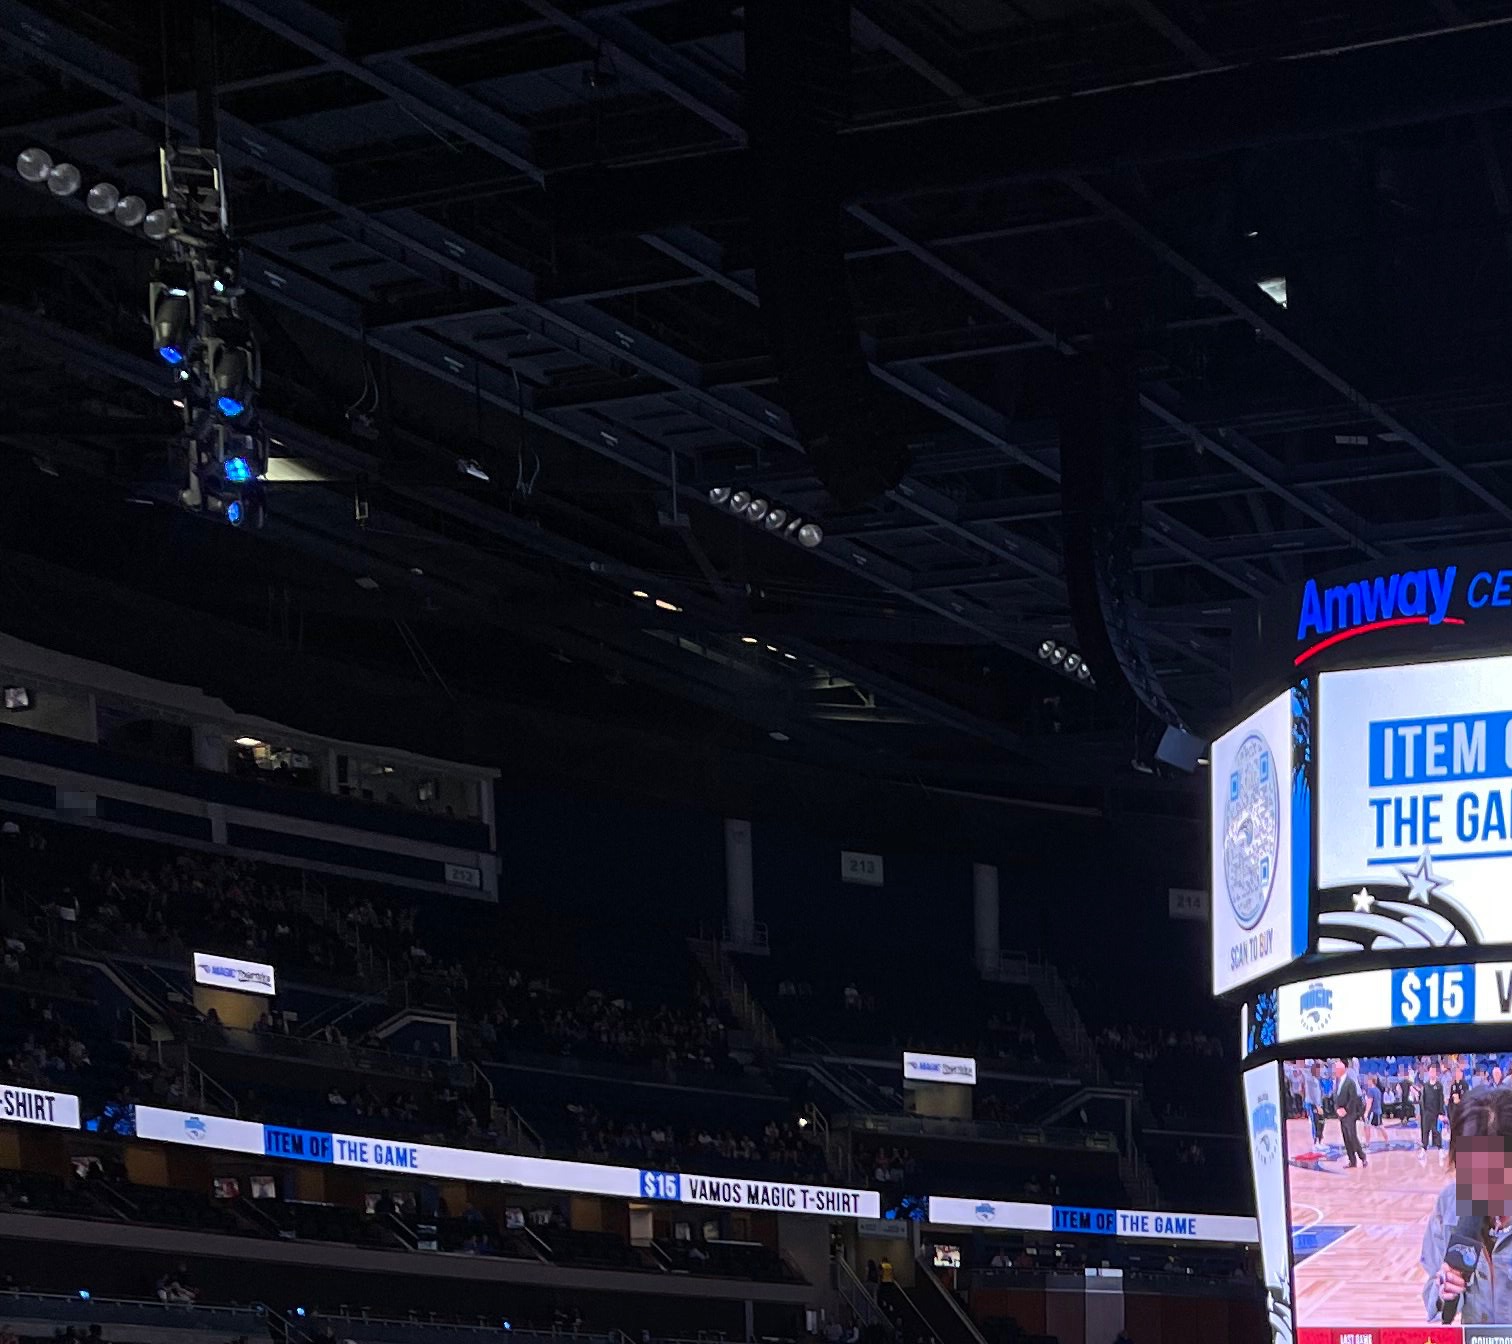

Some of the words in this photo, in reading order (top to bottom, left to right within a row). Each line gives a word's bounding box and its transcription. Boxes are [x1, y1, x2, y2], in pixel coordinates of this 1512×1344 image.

[1297, 565, 1458, 640] Amway
[1383, 719, 1486, 780] ITEM
[1369, 794, 1443, 848] THE
[1231, 941, 1249, 972] SCAN
[1249, 936, 1258, 962] TO
[1260, 928, 1273, 958] BUY
[1401, 968, 1465, 1022] $15
[266, 1131, 304, 1156] ITEM
[310, 1134, 330, 1159] OF
[337, 1139, 370, 1164] THE
[374, 1141, 418, 1169] GAME
[644, 1172, 677, 1199] $15
[689, 1179, 741, 1204] VAMOS
[747, 1183, 796, 1209] MAGIC
[801, 1189, 860, 1214] T-SHIRT
[1054, 1209, 1091, 1230] ITEM
[1096, 1213, 1114, 1231] OF
[1119, 1214, 1149, 1232] THE
[1154, 1216, 1197, 1235] GAME
